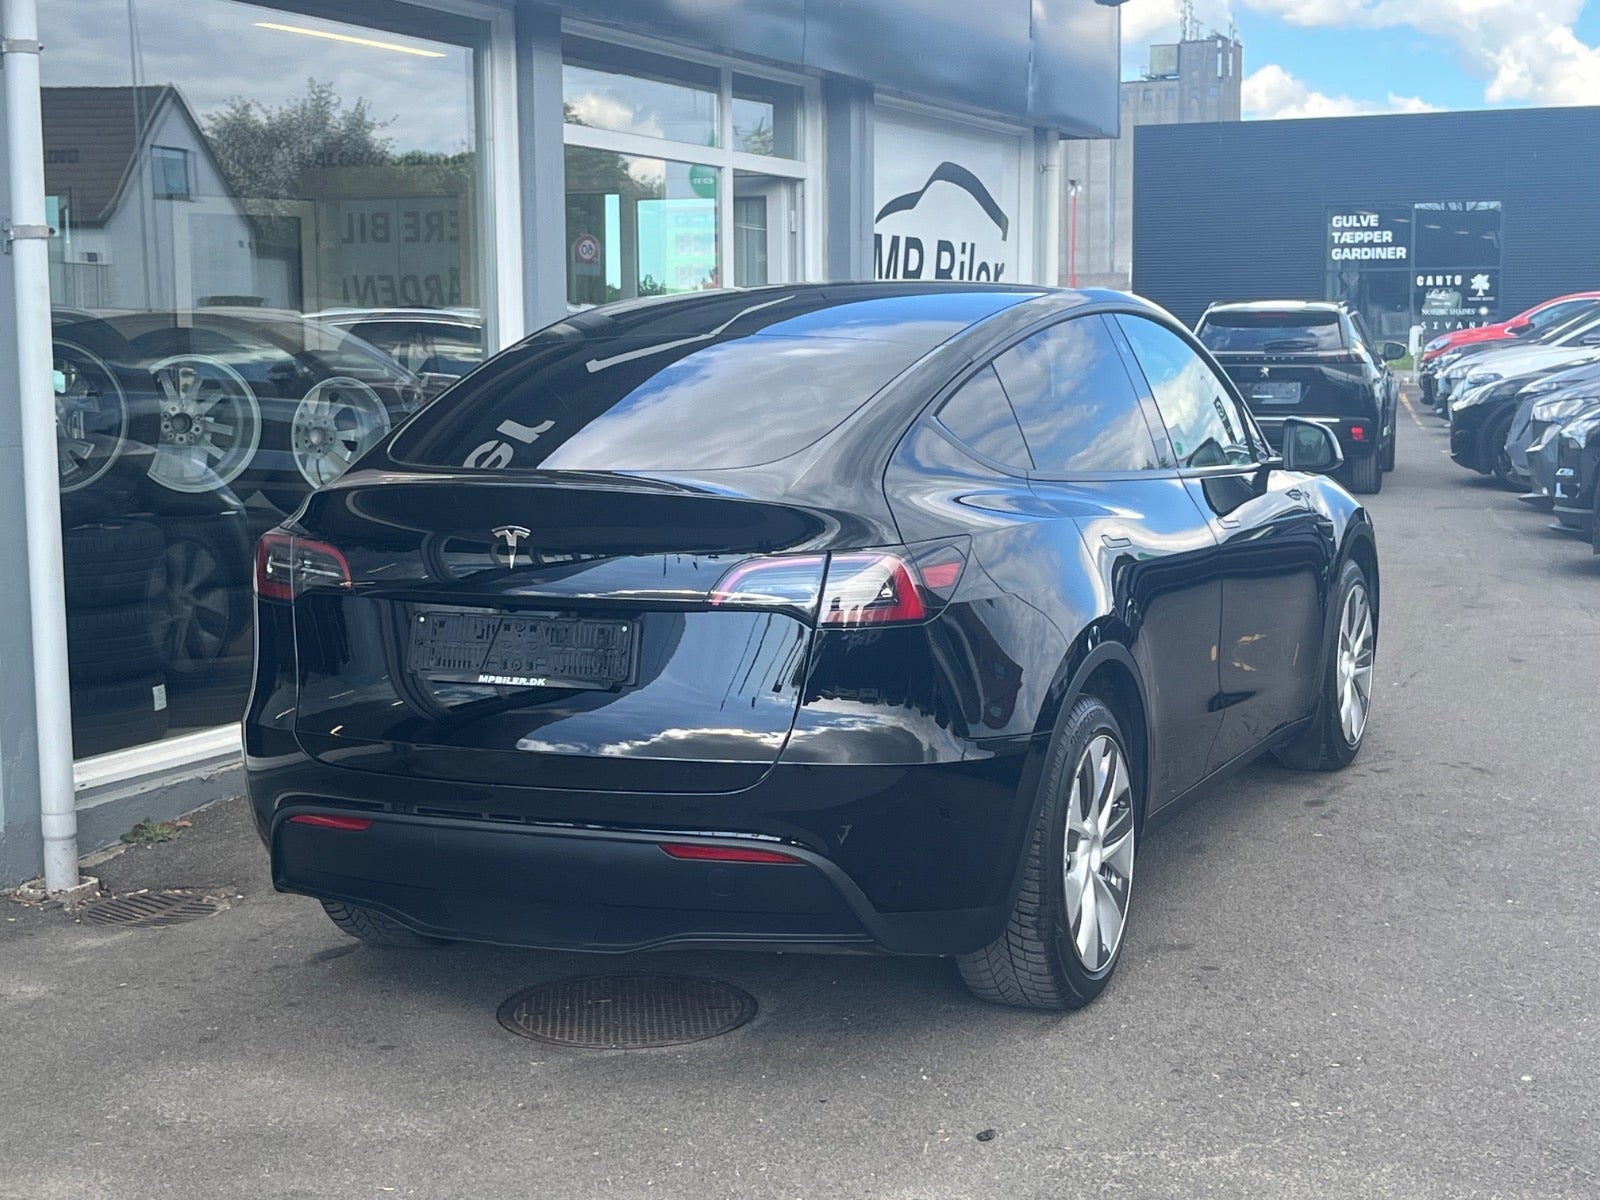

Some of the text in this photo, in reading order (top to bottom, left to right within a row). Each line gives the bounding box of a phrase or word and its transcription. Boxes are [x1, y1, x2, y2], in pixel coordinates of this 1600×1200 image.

[1332, 214, 1379, 228] GULVE
[1332, 230, 1393, 244] TÆPPER
[1331, 246, 1407, 260] GARDINER
[478, 674, 546, 686] MPBILER.DK
